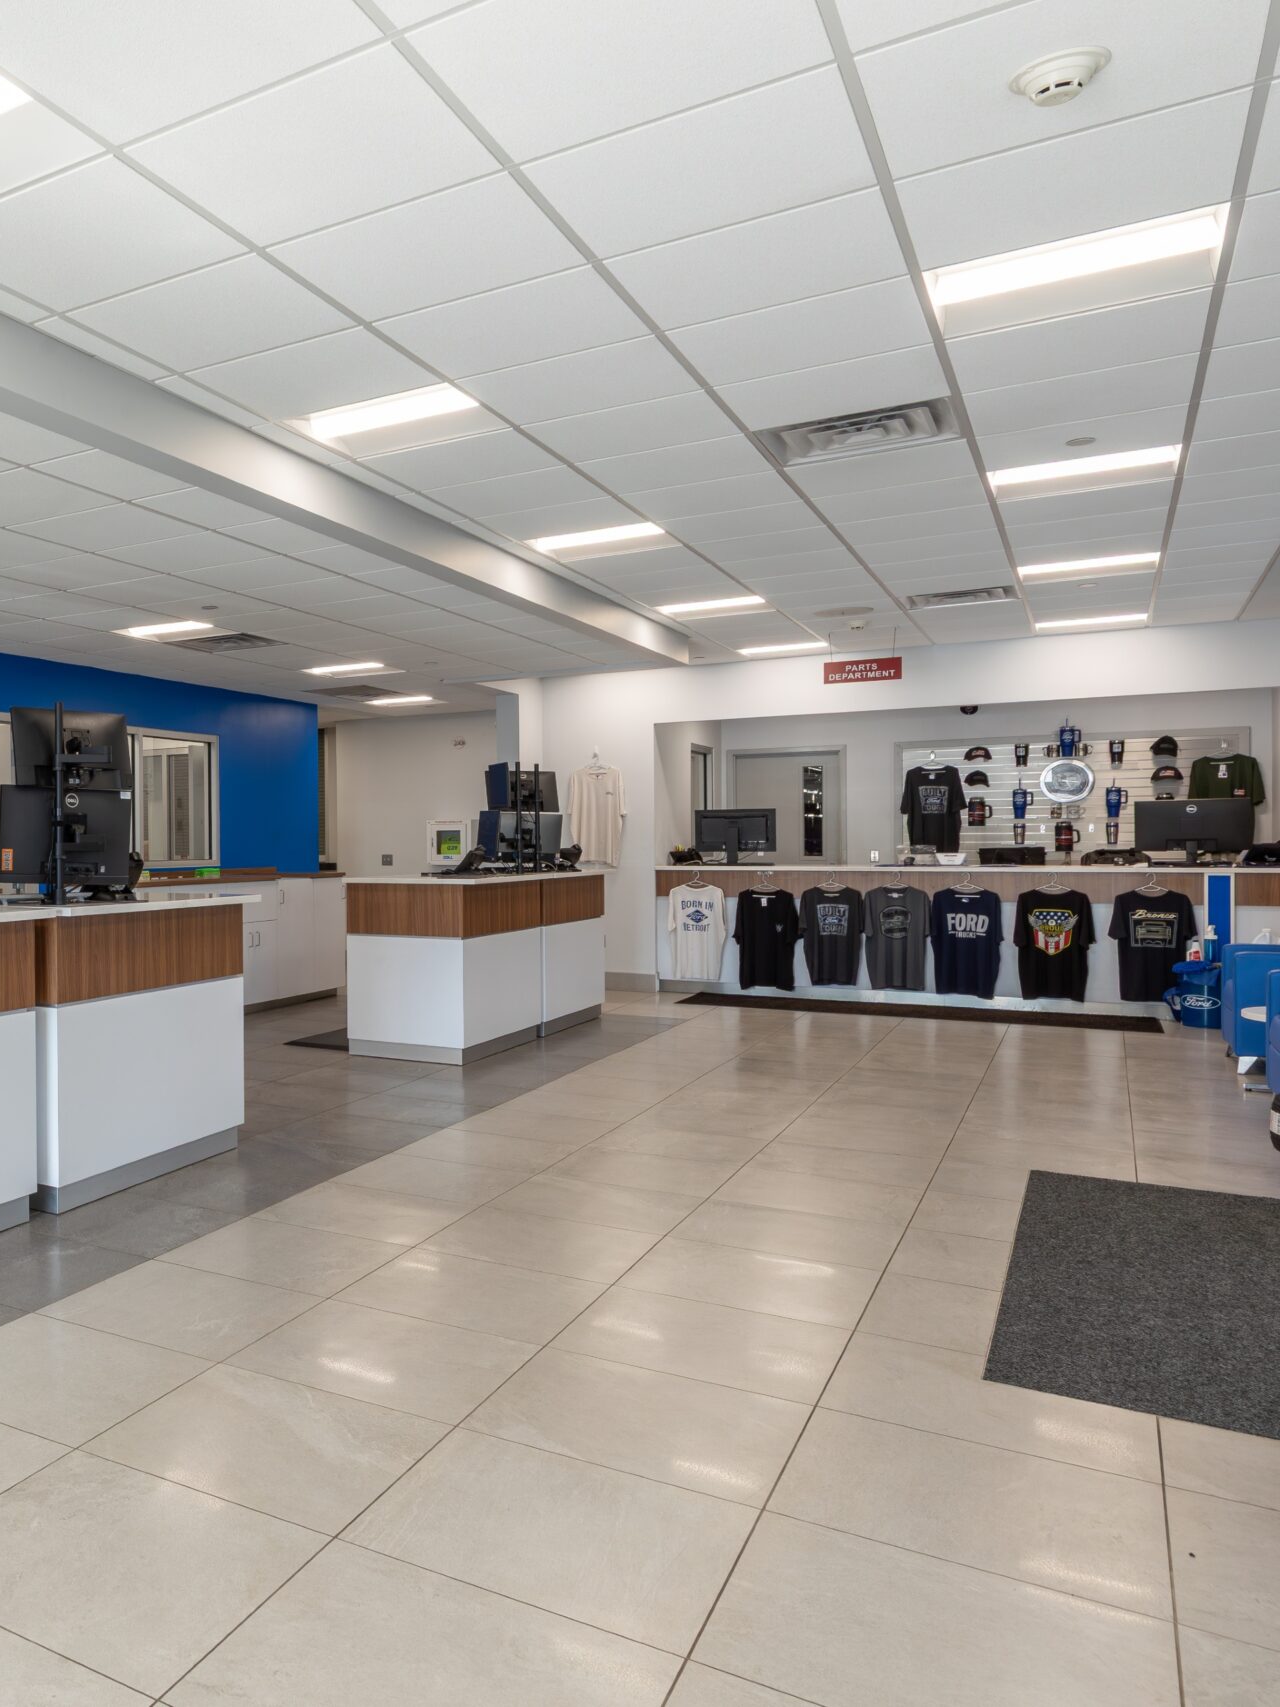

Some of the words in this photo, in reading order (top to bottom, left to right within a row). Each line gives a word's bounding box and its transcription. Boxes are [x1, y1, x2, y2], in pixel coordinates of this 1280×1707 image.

[845, 663, 878, 672] PARTS
[828, 669, 896, 681] DEPARTMENT
[922, 788, 946, 797] BUILT
[681, 900, 703, 910] BORN
[705, 901, 714, 911] IN
[820, 907, 845, 916] BUILT
[1131, 909, 1177, 919] Bronco
[946, 913, 989, 933] FORD
[1185, 996, 1213, 1007] Ford
